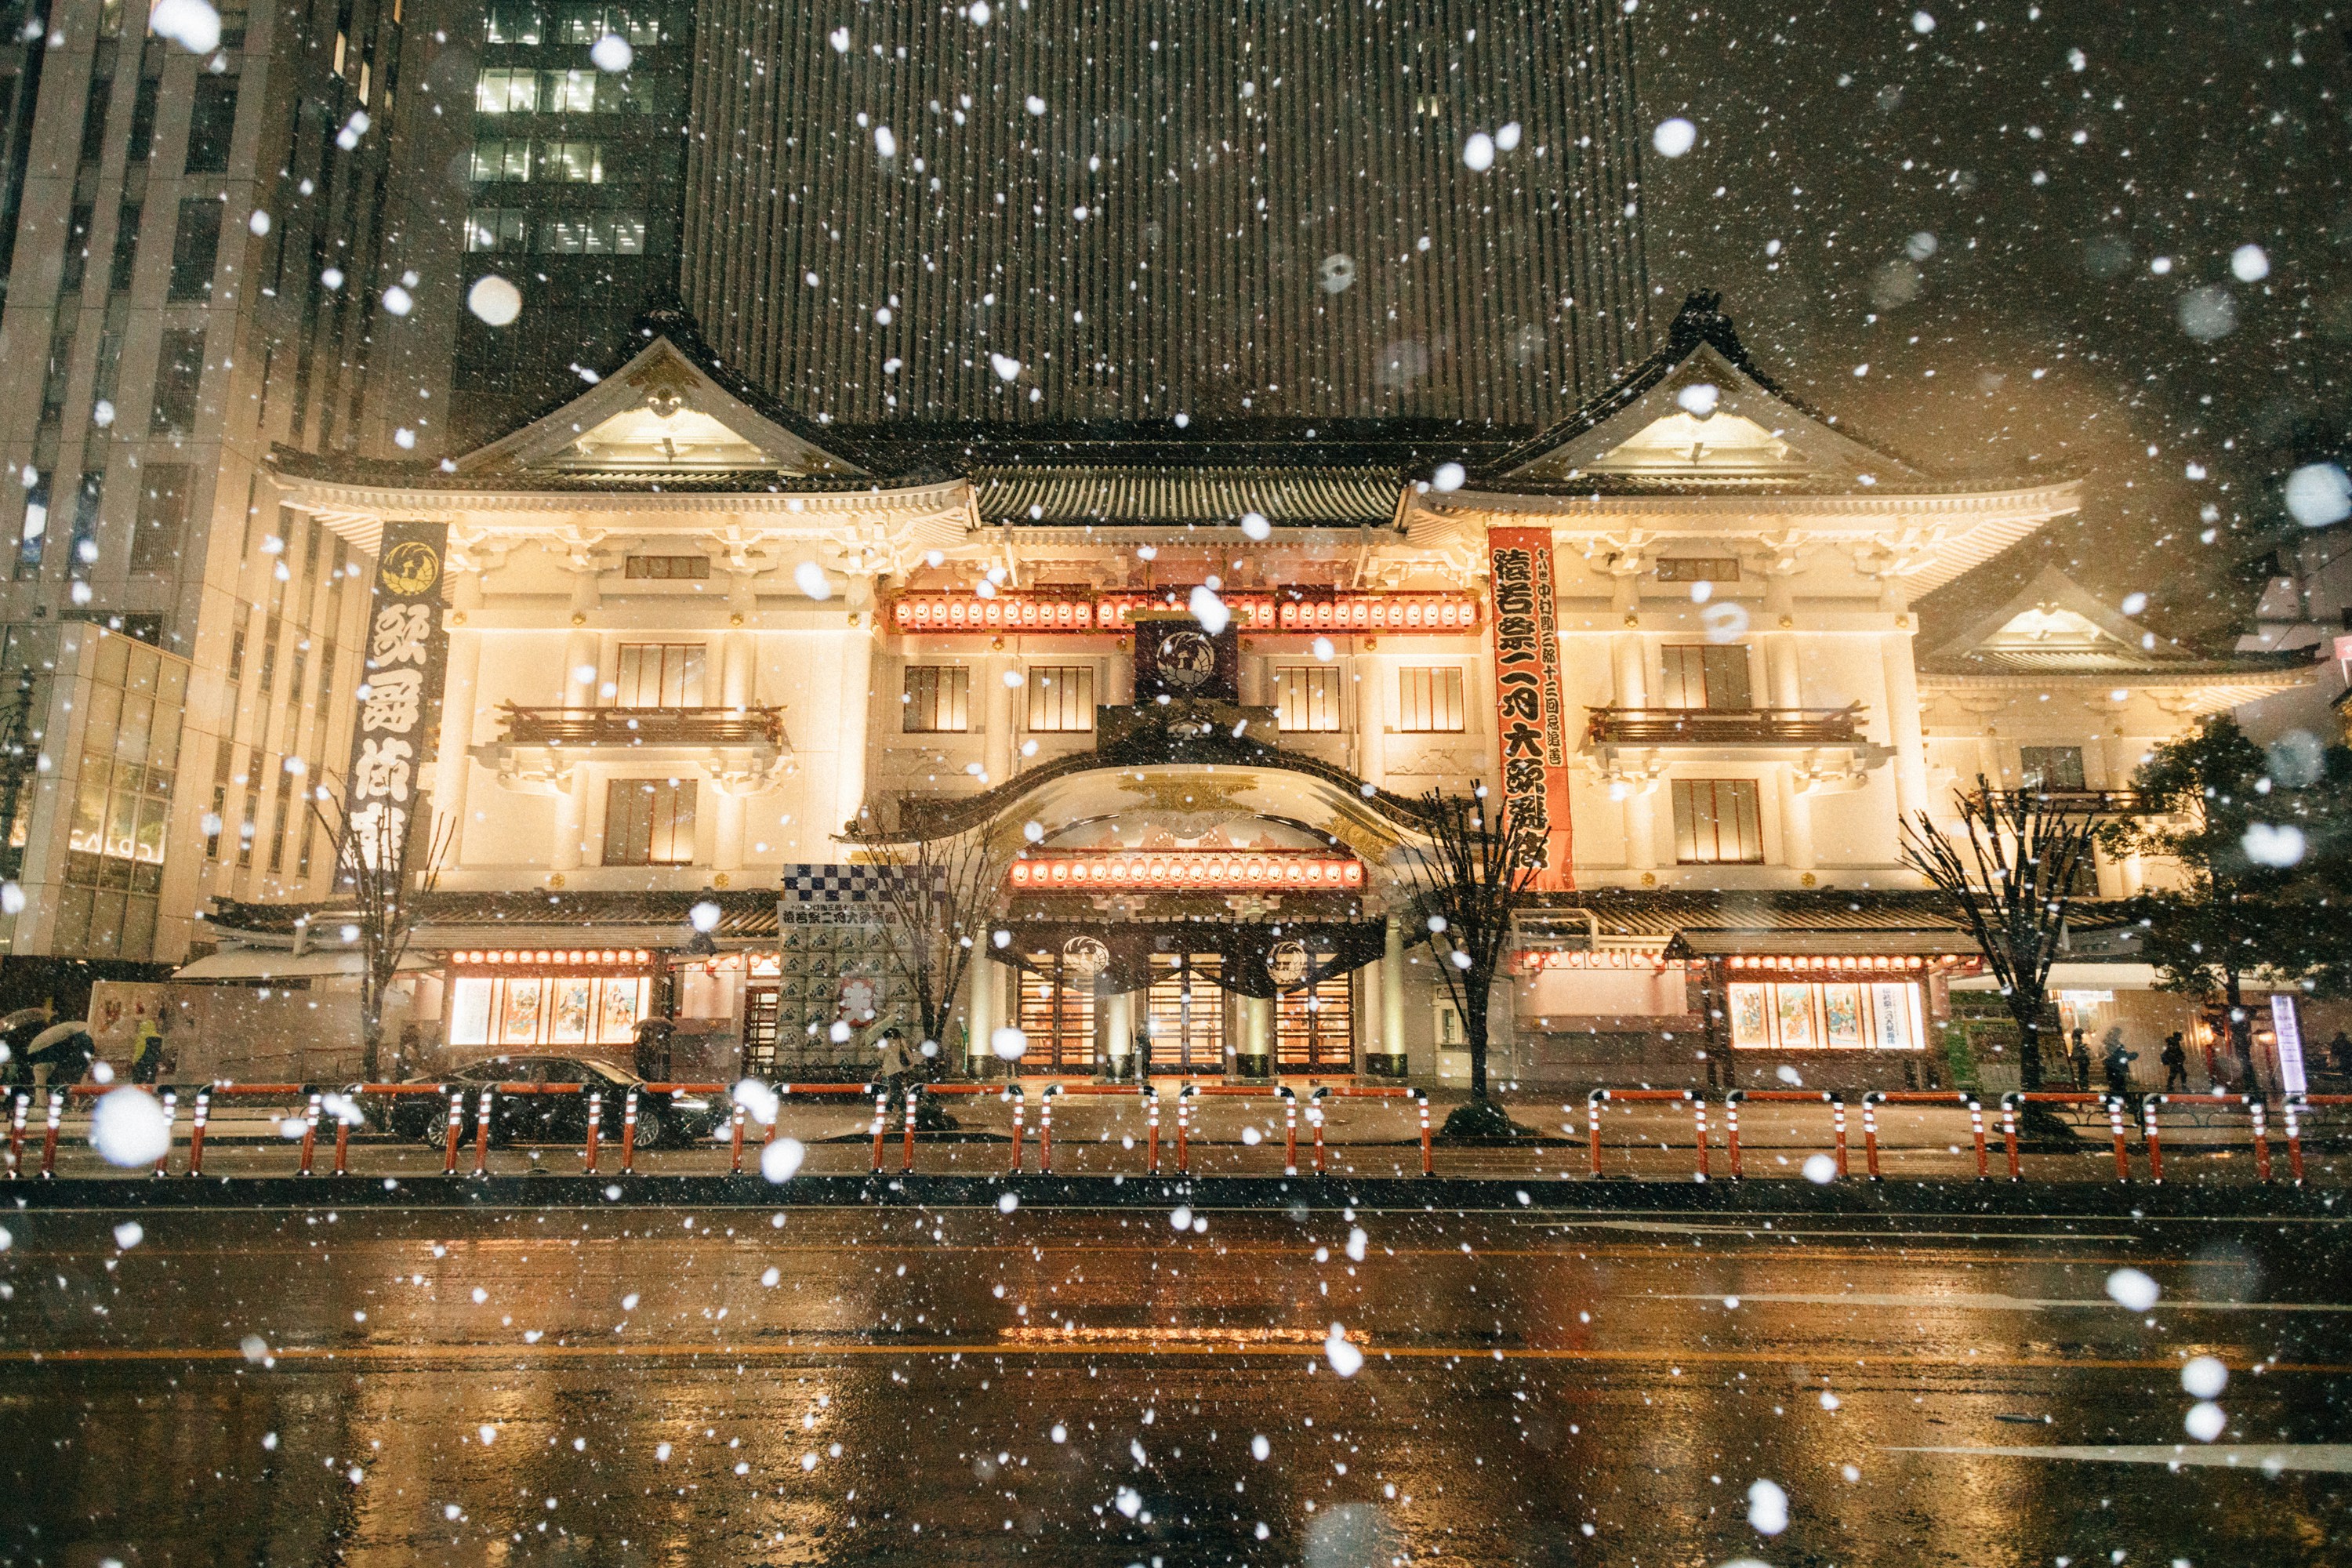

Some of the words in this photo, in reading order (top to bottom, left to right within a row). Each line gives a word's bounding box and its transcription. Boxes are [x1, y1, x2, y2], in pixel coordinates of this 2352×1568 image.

[1493, 548, 1548, 869] 猿若祭二月大歌舞伎
